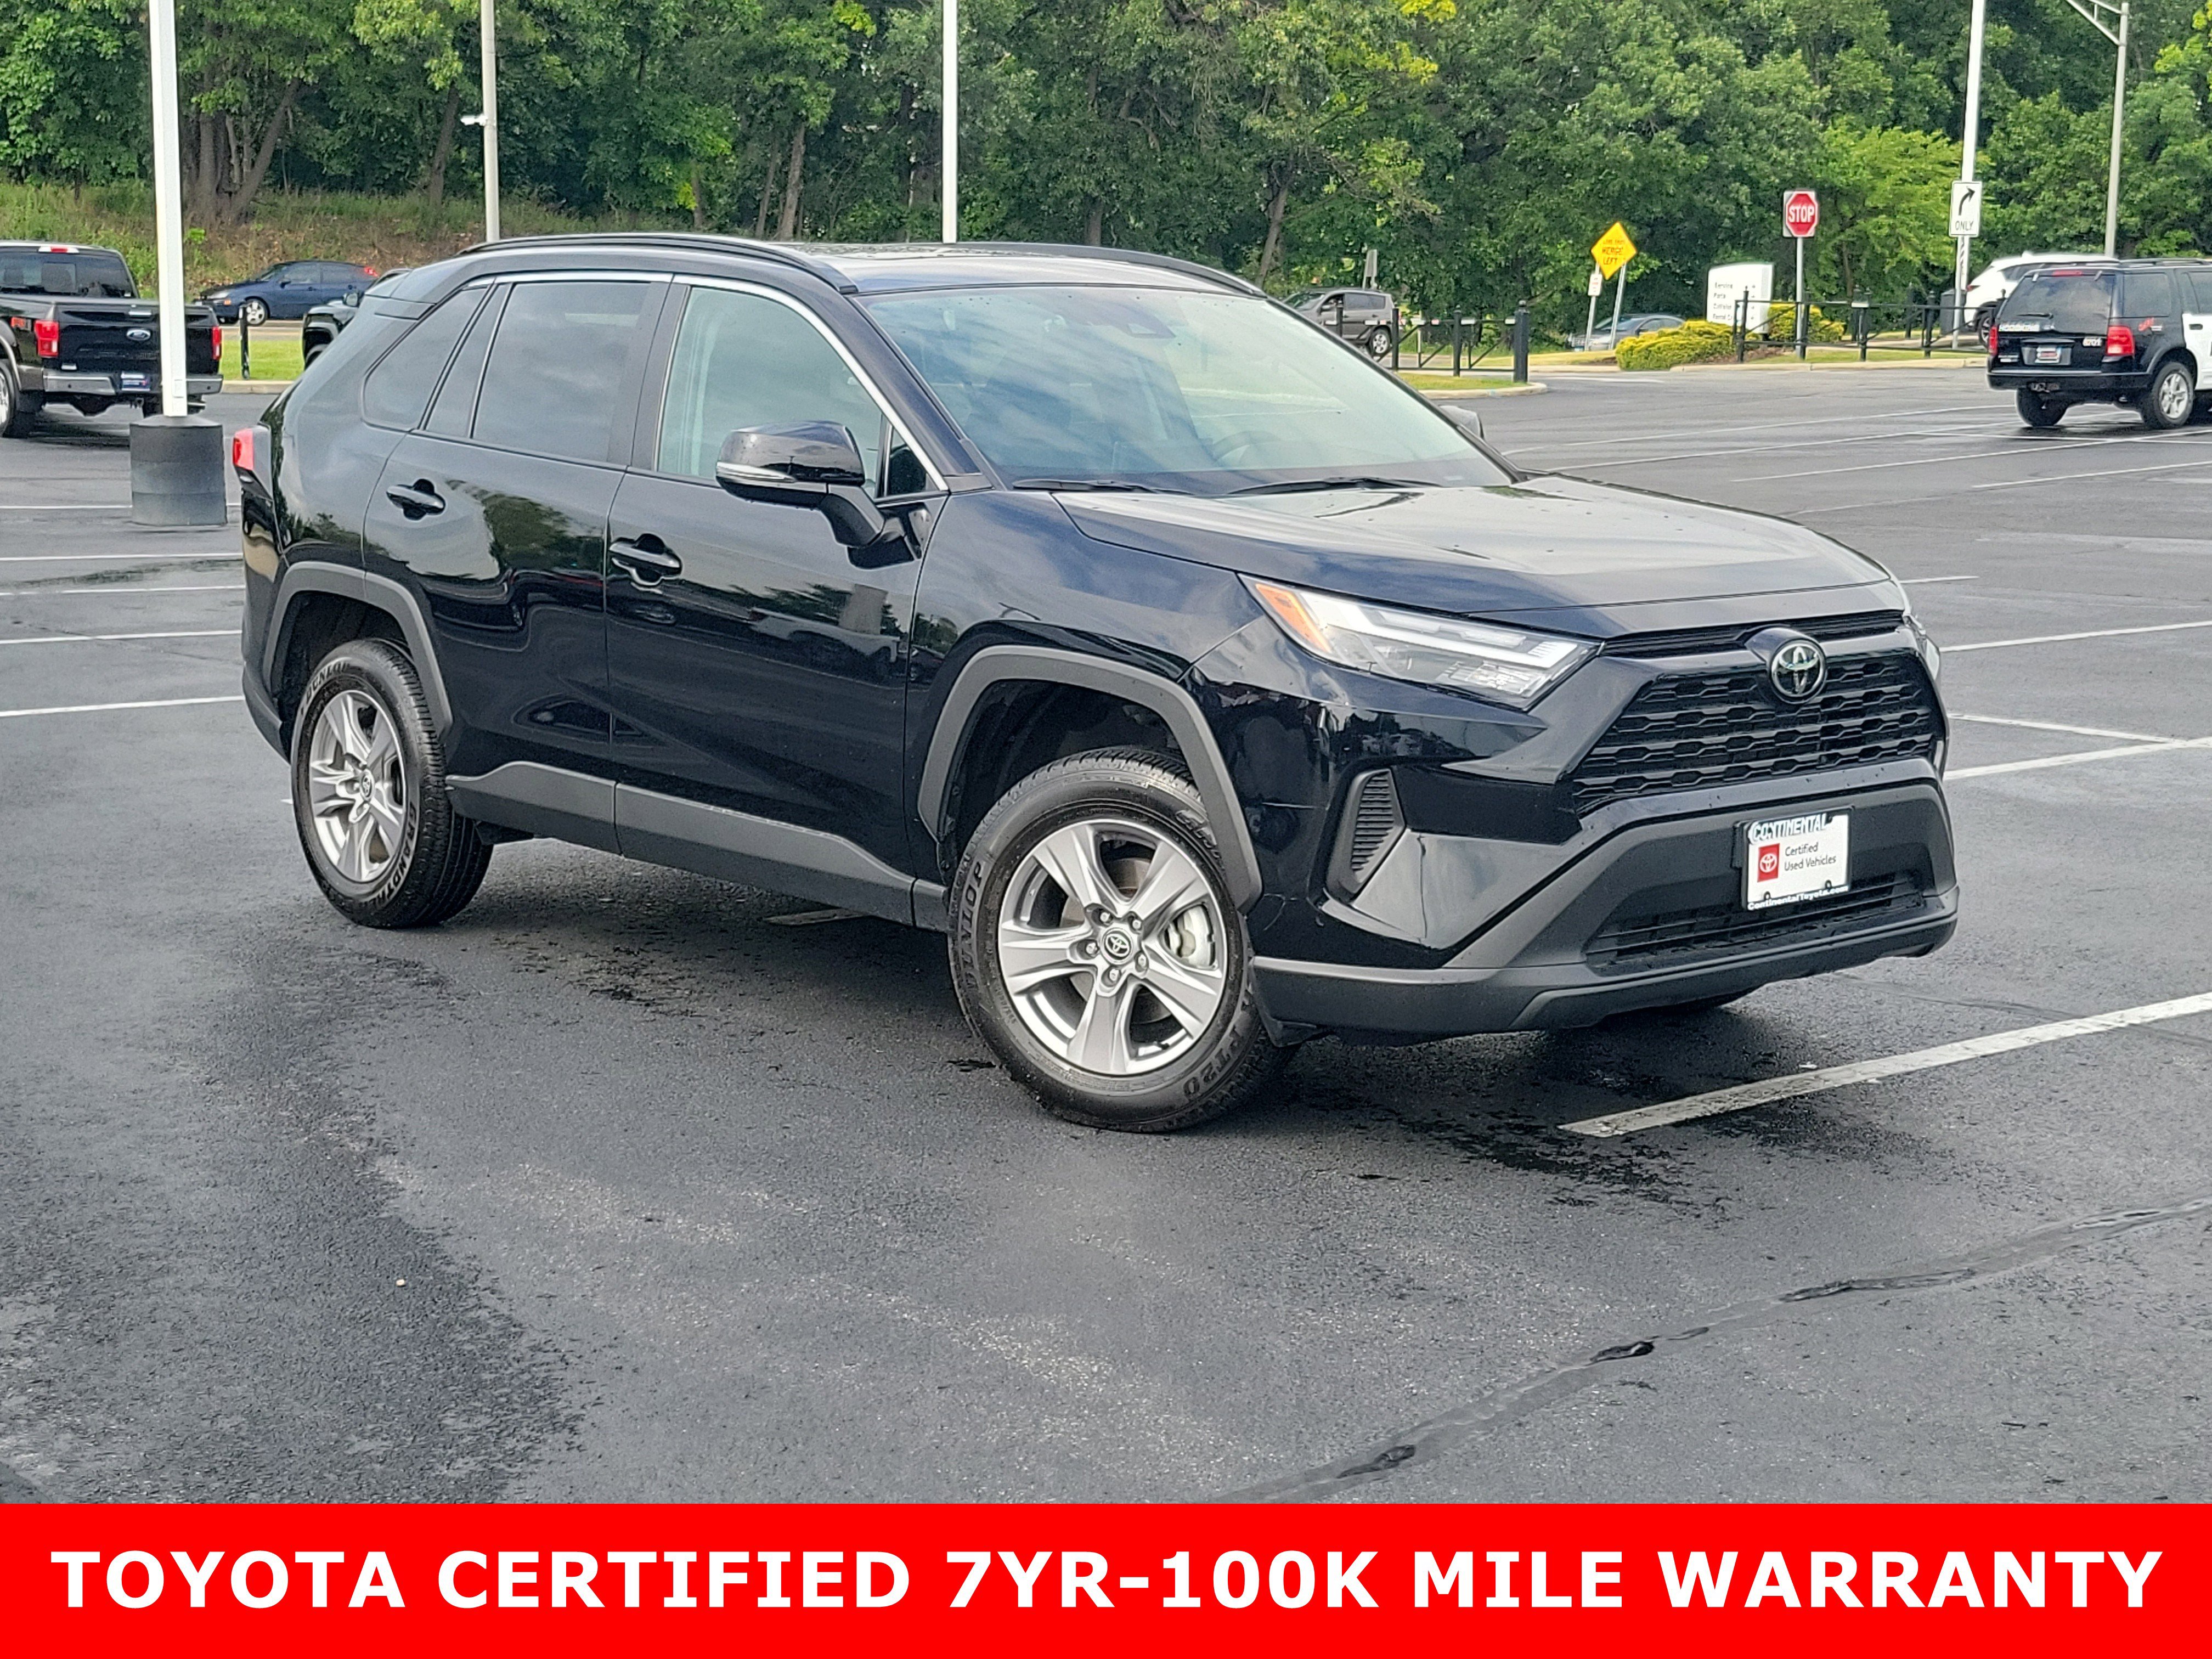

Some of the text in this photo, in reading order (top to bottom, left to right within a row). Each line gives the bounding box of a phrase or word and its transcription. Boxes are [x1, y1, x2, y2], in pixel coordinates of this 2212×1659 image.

[1788, 204, 1815, 223] STOP
[1955, 220, 1974, 231] ONLY
[1602, 257, 1618, 265] LEFT
[307, 661, 350, 704] DUNLOP
[1748, 812, 1827, 843] CONTINENTAL
[1785, 842, 1819, 856] Certified
[1784, 854, 1837, 871] Used Vehicles
[1747, 885, 1849, 911] ContinentalToyota.com
[961, 861, 983, 989] DUNLOP
